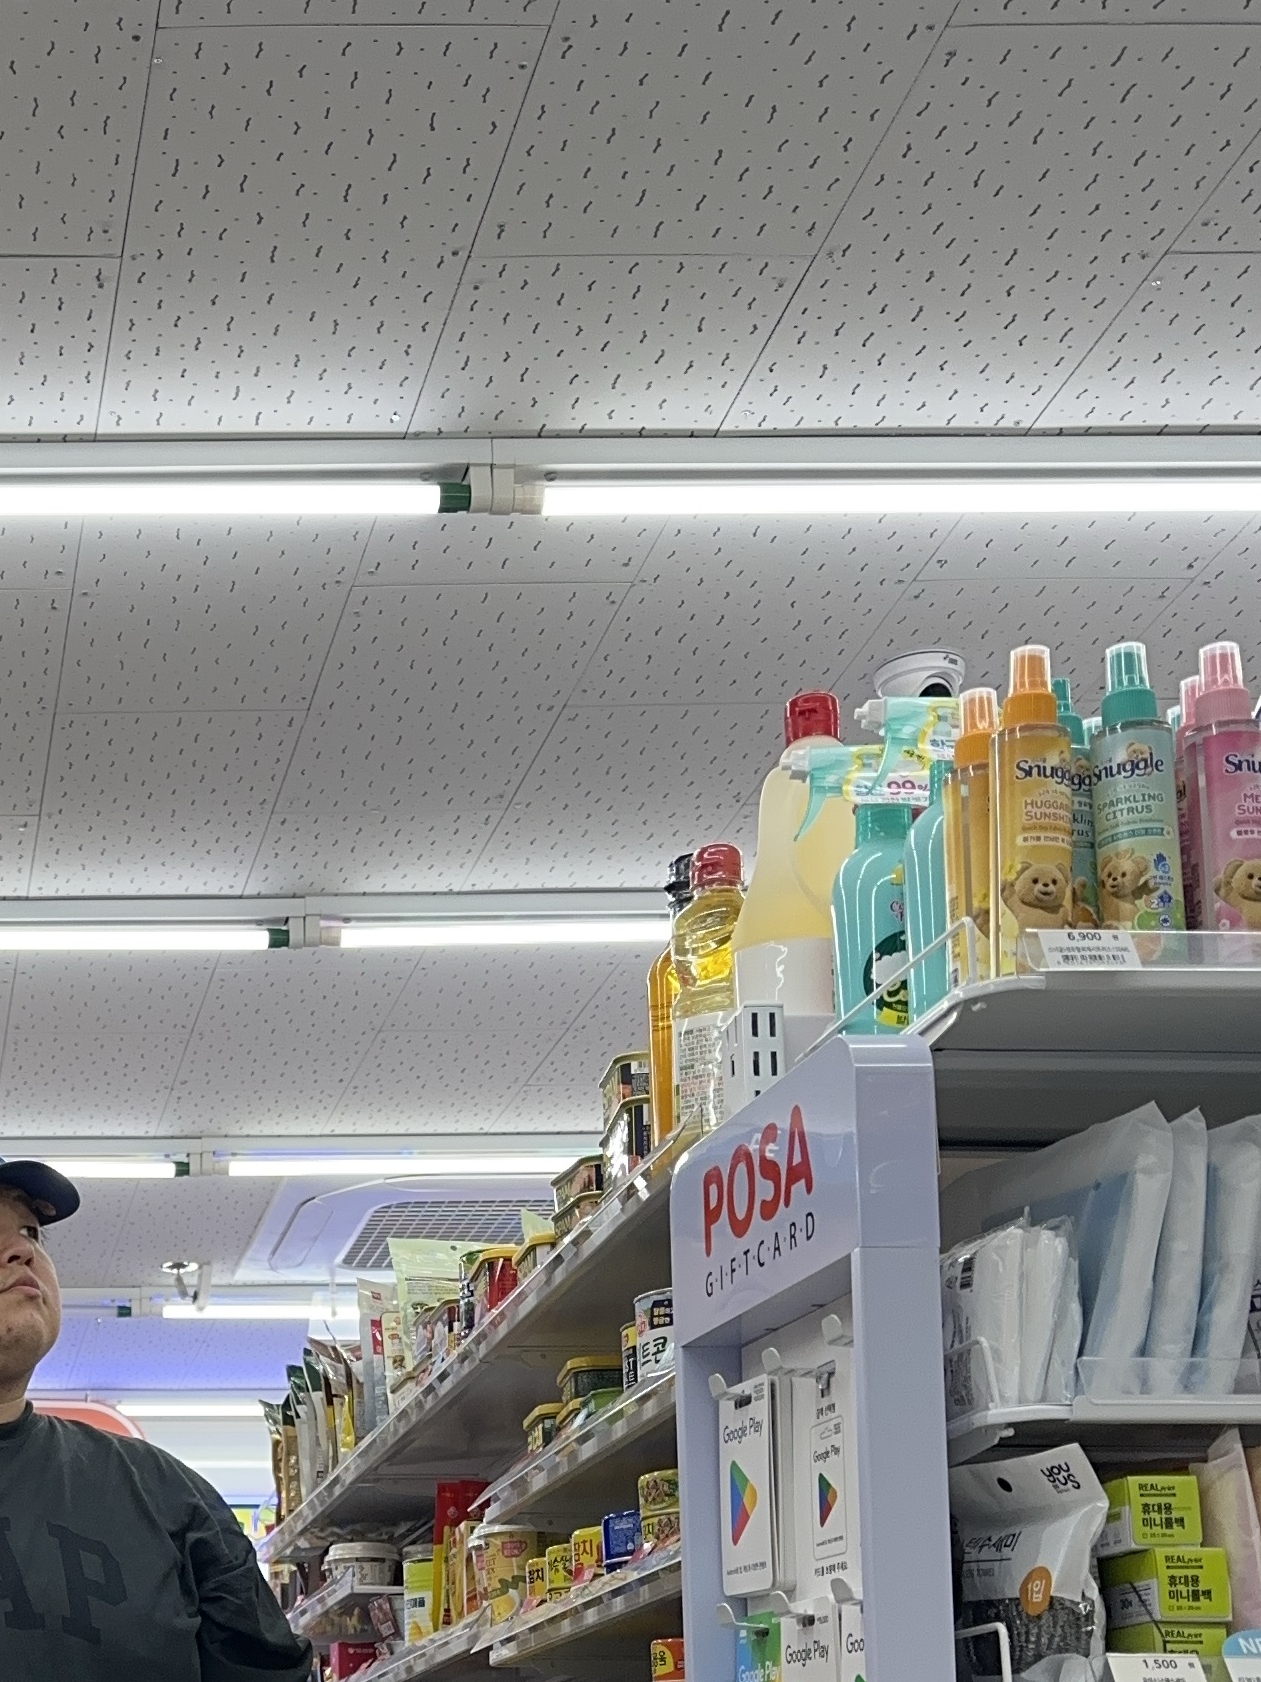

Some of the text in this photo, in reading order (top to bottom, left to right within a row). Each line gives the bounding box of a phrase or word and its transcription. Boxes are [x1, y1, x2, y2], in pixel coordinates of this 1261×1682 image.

[1093, 751, 1165, 787] Snuggle
[1096, 792, 1164, 814] SPARKLING
[1105, 803, 1154, 822] CITRUS
[1067, 932, 1102, 942] 6,900
[701, 1103, 814, 1258] POSA
[722, 1418, 764, 1445] Google Play
[812, 1444, 841, 1465] Google Play
[1141, 1503, 1173, 1516] 휴대용
[1168, 1575, 1200, 1588] 휴대용
[785, 1640, 830, 1667] Google Play
[764, 1660, 781, 1682] Play
[1142, 1659, 1178, 1670] 1,500
